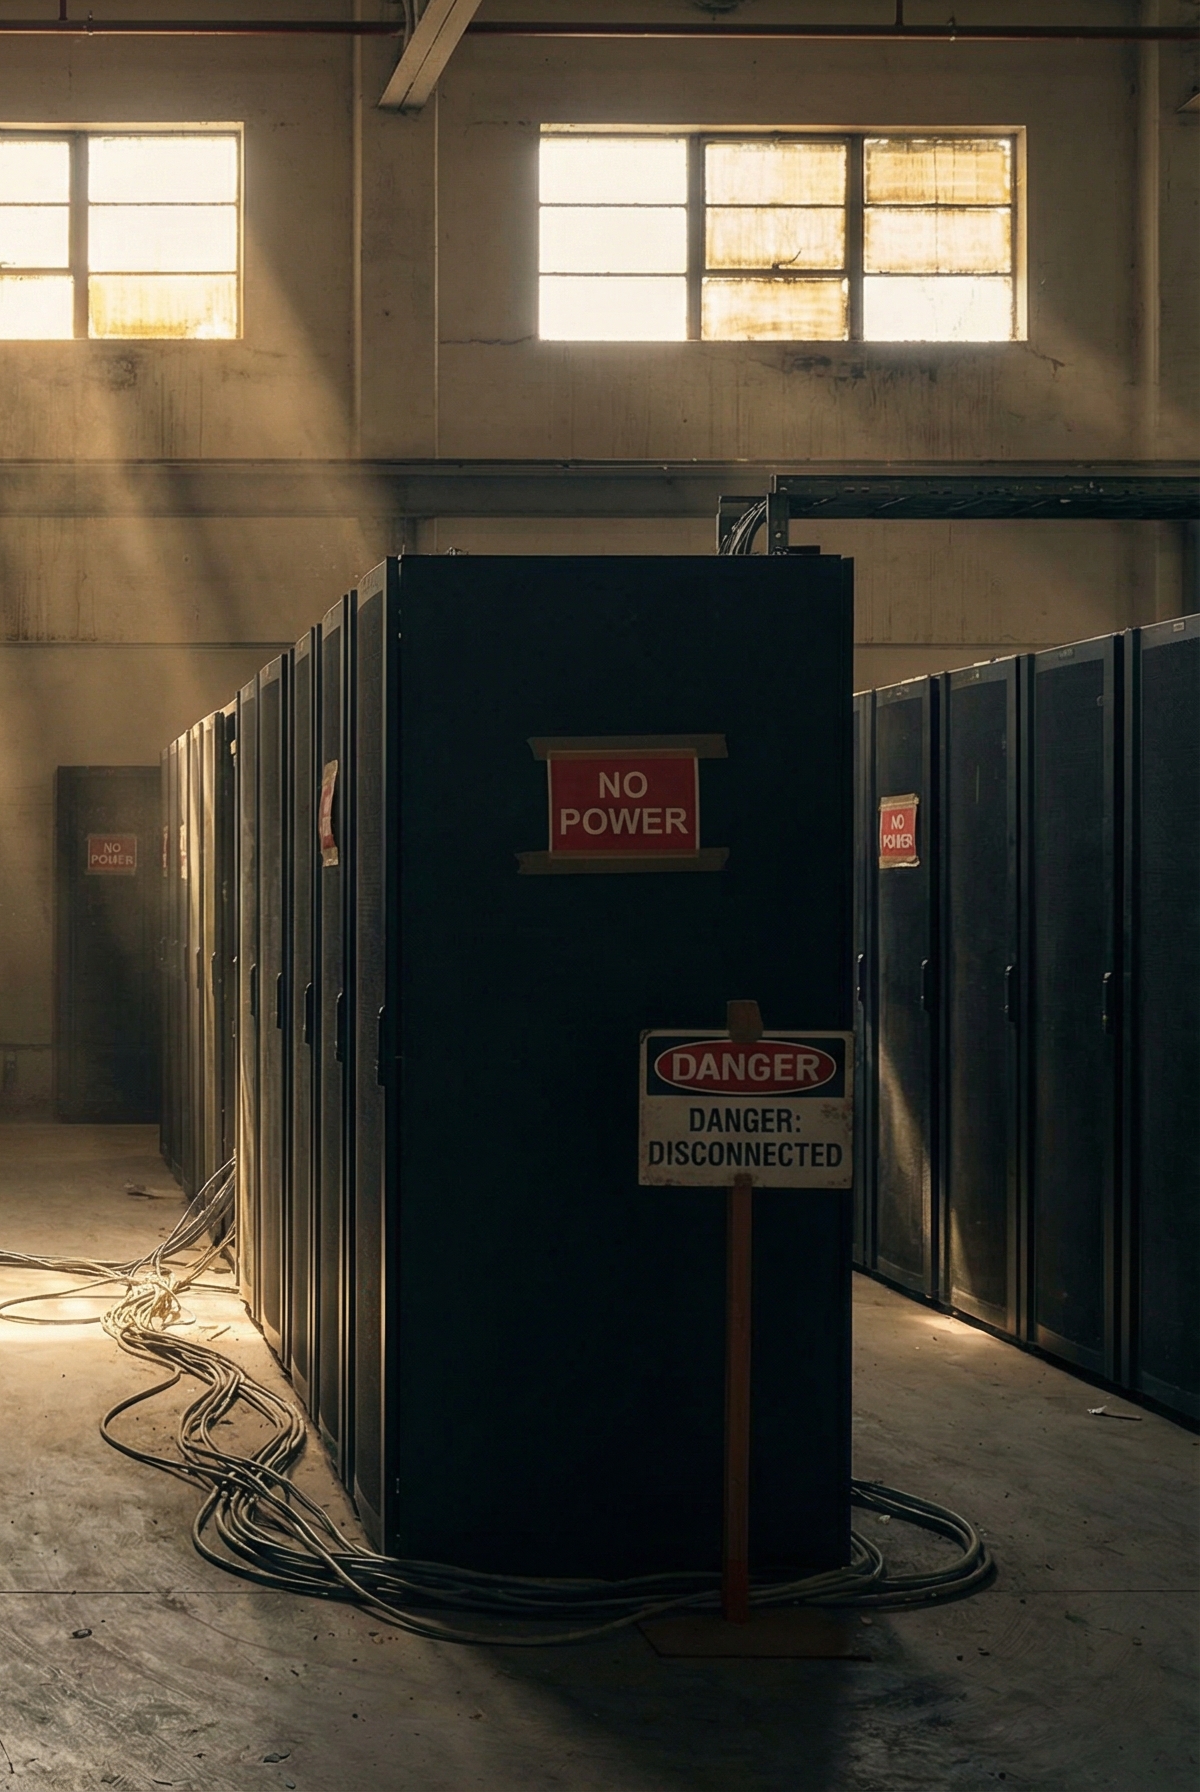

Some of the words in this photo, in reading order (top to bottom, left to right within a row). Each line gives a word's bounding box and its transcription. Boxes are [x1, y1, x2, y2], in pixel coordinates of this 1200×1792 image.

[599, 770, 649, 799] NO
[560, 807, 689, 836] POWER
[891, 813, 905, 831] NO
[103, 842, 122, 854] NO
[671, 1052, 821, 1082] DANGER
[689, 1107, 801, 1133] DANGER:
[649, 1140, 843, 1168] DISCONNECTED
